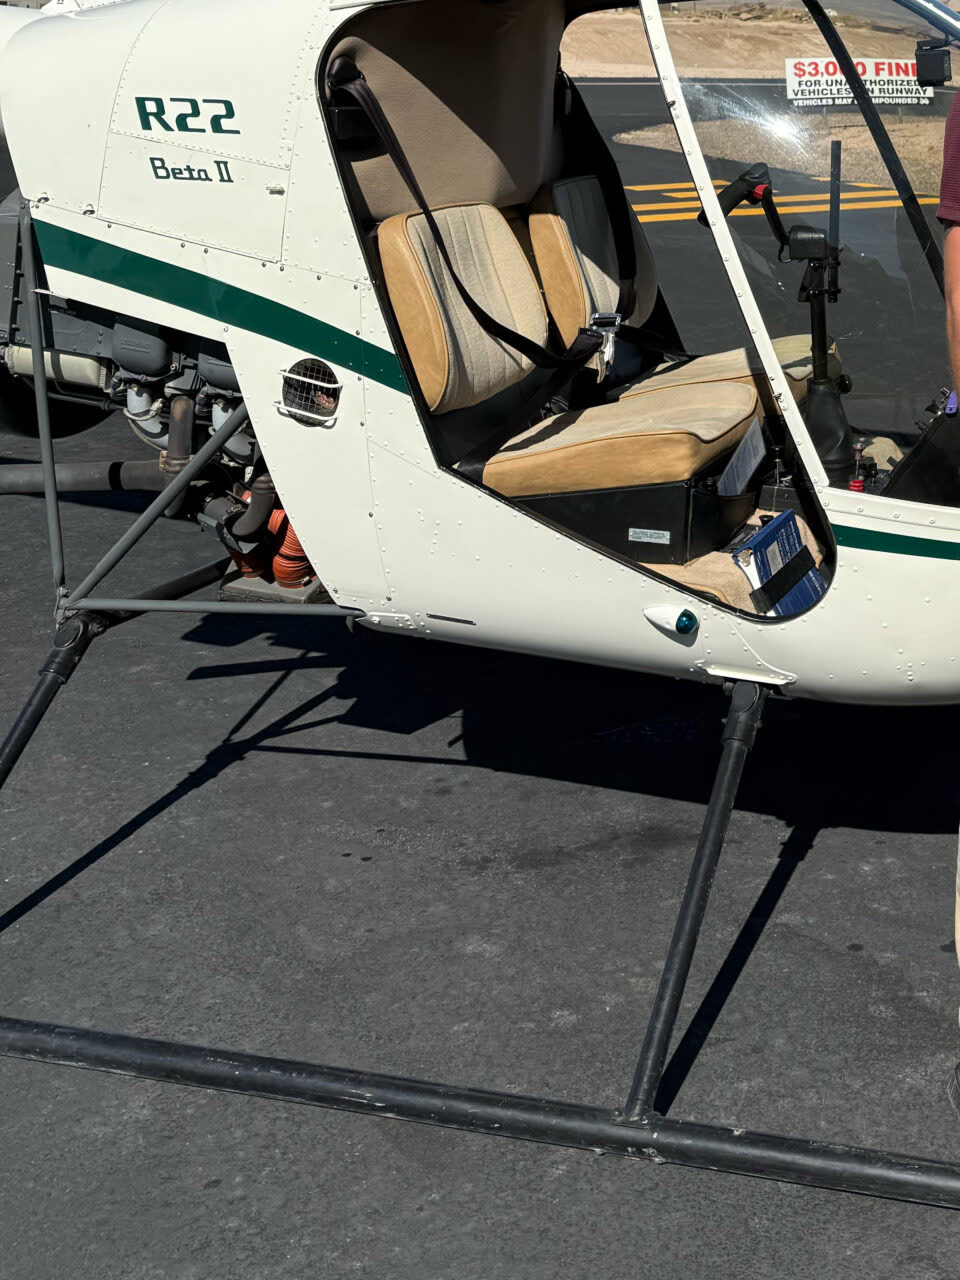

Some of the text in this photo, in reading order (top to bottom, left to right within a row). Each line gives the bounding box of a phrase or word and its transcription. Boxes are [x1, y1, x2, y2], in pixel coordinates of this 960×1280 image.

[793, 60, 867, 78] $3,00
[798, 79, 919, 88] FOR UNTHORIZED
[792, 87, 852, 97] VEHICLES
[878, 87, 928, 96] RUNWAY
[871, 97, 918, 105] MPOUNDED
[135, 97, 241, 135] R22
[149, 157, 234, 183] Beta II
